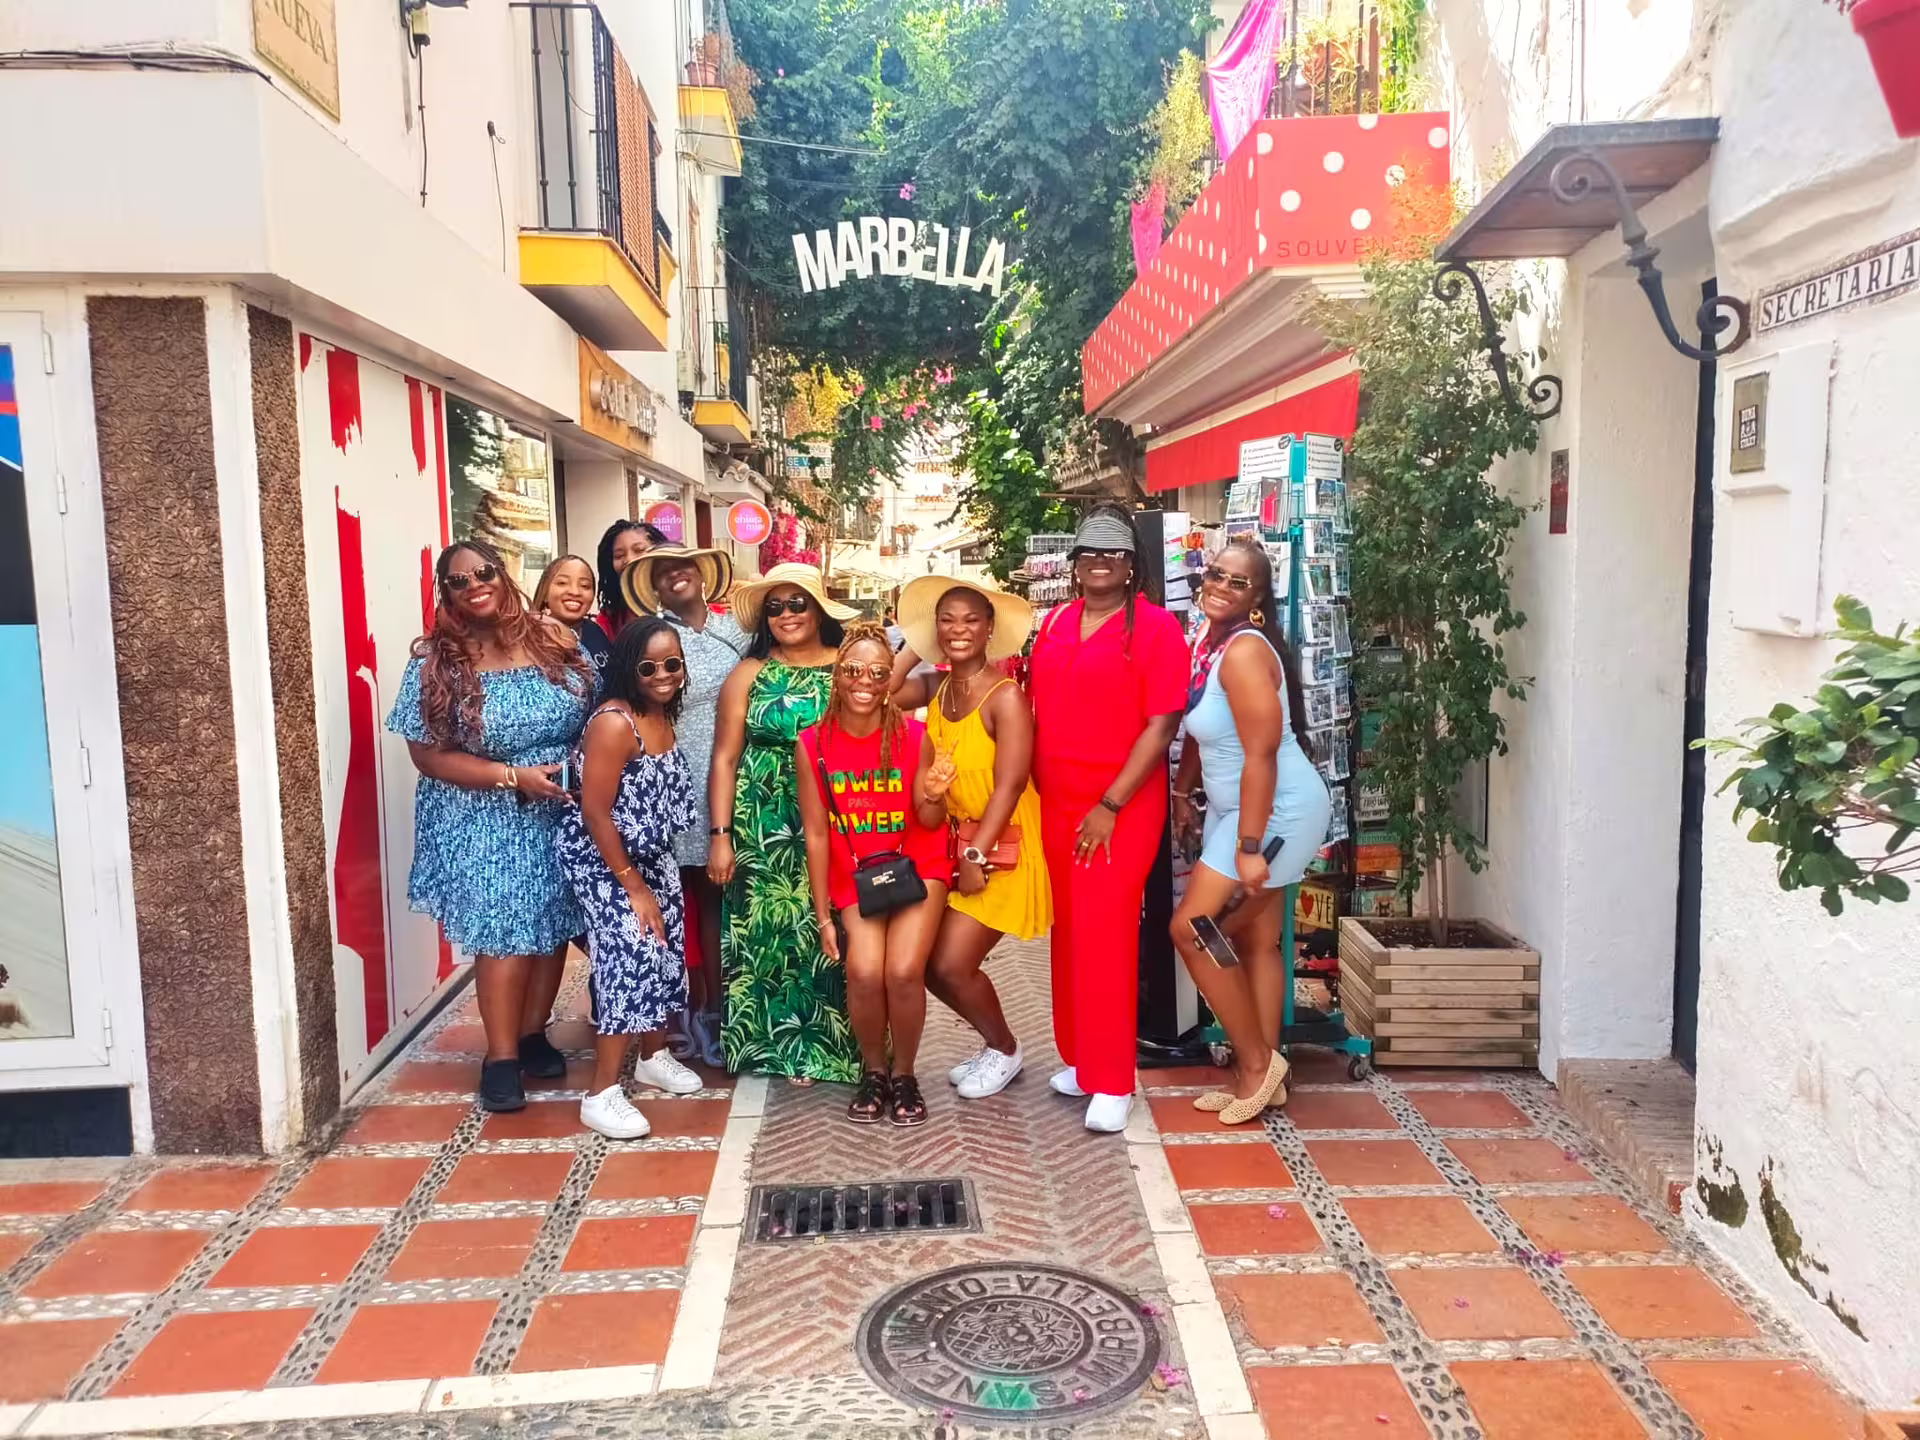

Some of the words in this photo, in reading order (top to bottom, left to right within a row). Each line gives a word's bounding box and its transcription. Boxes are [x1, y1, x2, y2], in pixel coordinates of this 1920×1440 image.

[791, 216, 1006, 298] MARBELLA
[1760, 246, 1915, 328] SECRETARIA
[828, 769, 904, 795] OWER
[847, 798, 877, 809] PAS
[1018, 1273, 1140, 1388] MARBELLA
